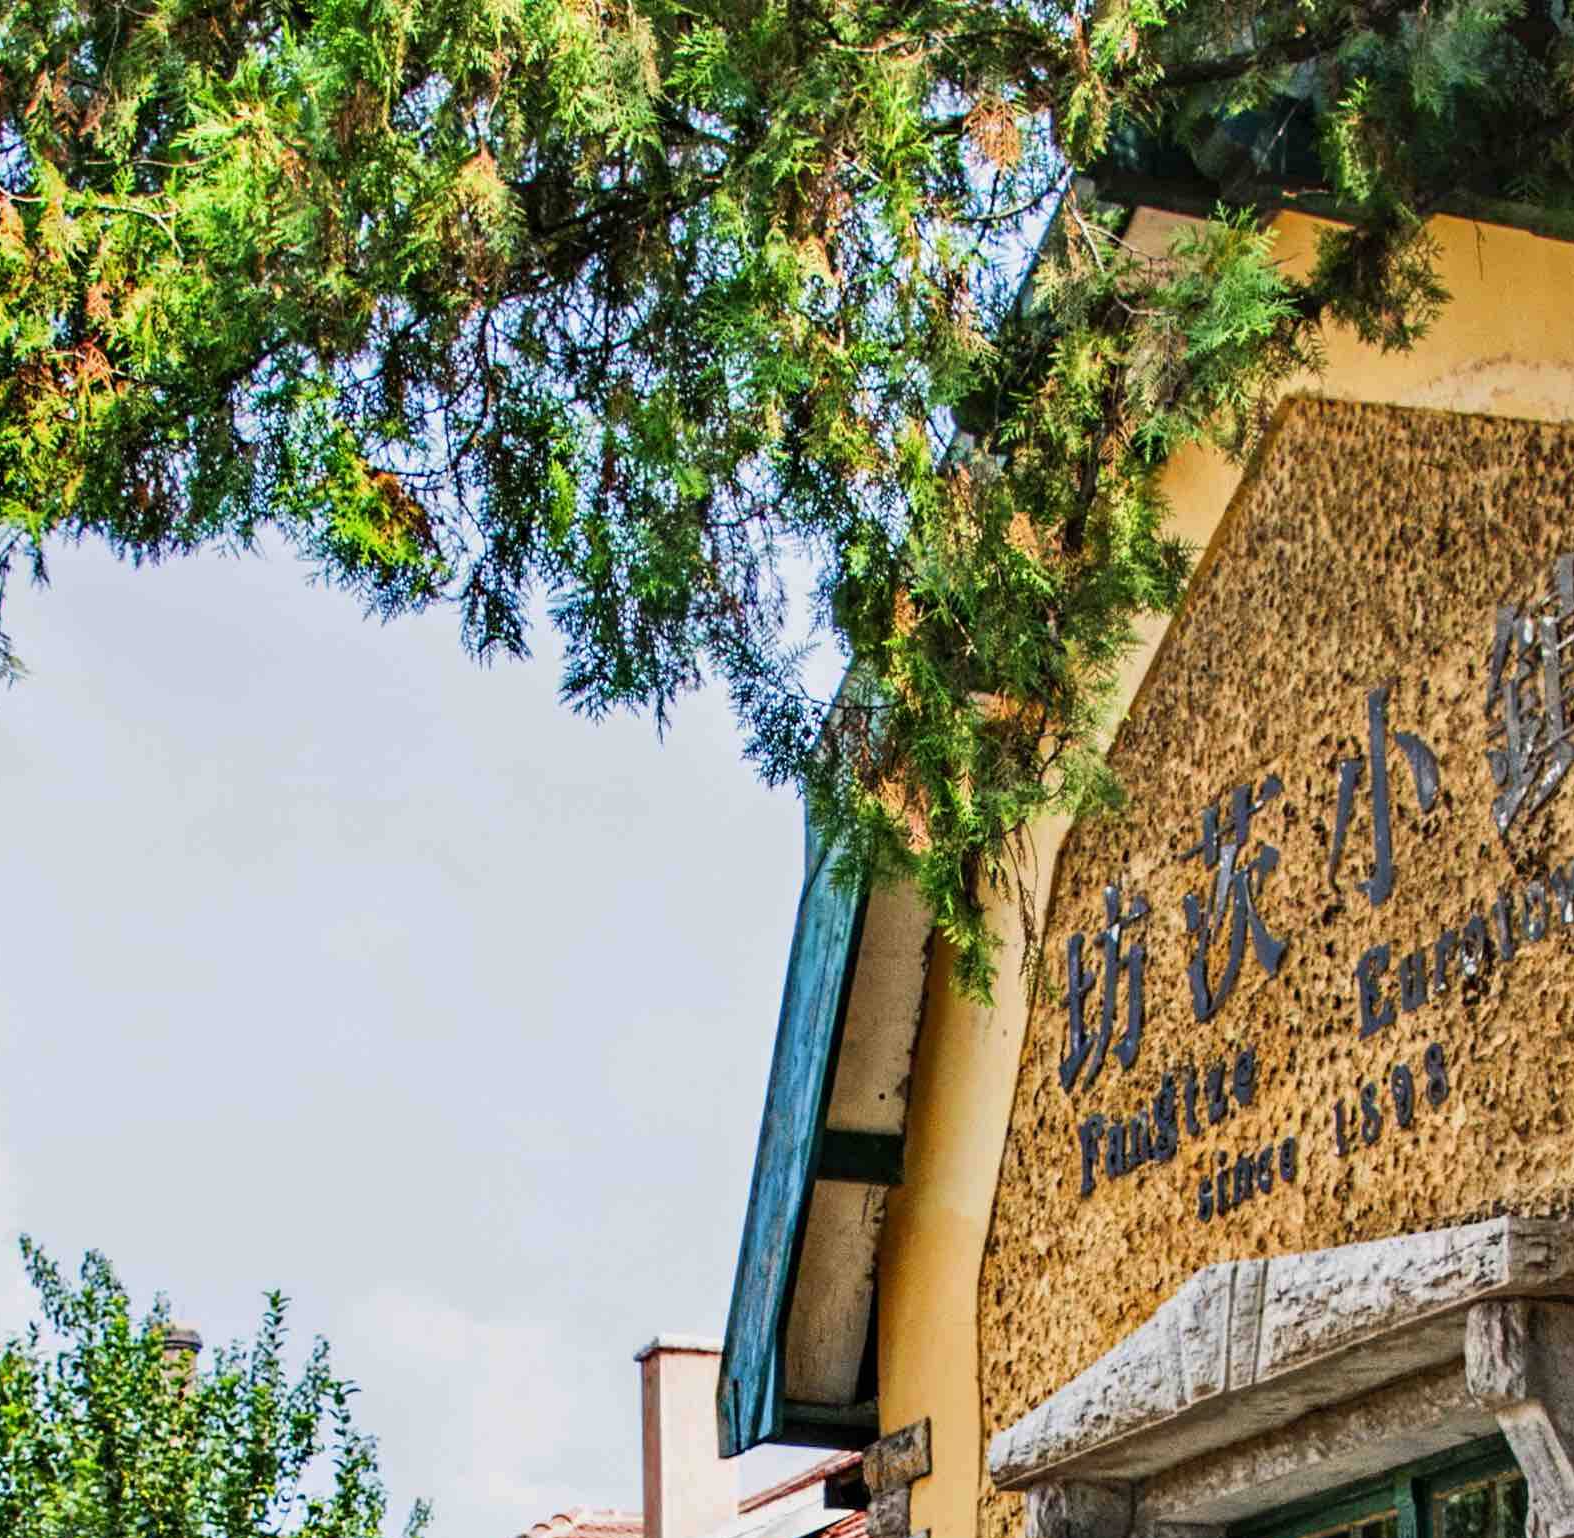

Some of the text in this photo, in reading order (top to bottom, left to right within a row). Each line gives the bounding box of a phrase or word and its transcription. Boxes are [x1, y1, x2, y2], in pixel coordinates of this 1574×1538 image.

[1079, 1049, 1257, 1196] Fangtze
[1197, 1042, 1449, 1222] since 1898
